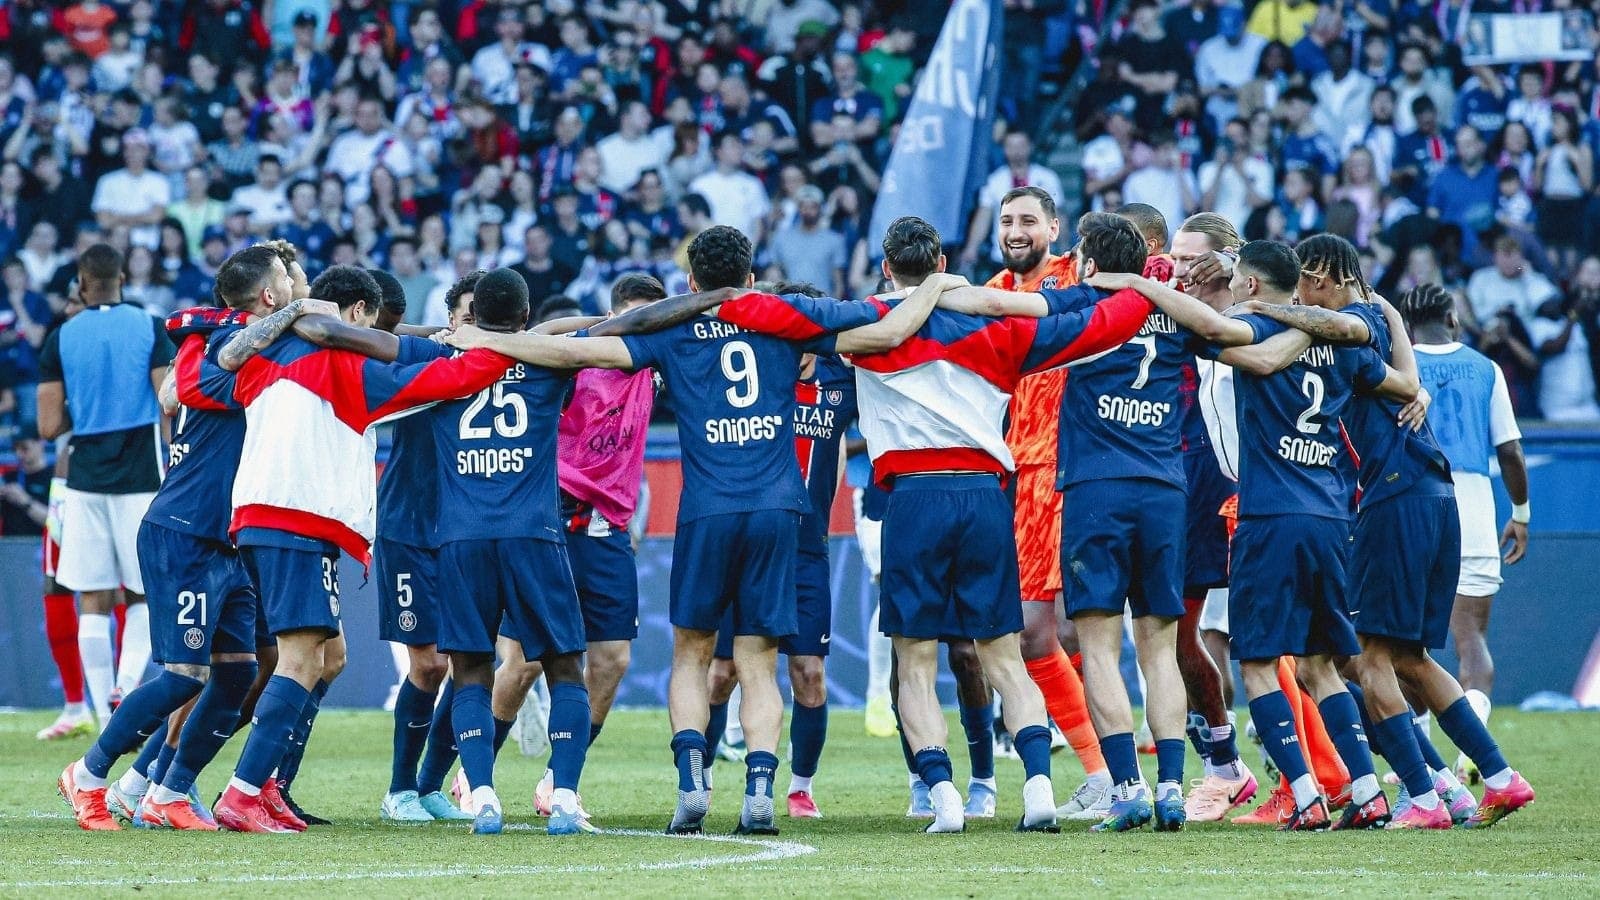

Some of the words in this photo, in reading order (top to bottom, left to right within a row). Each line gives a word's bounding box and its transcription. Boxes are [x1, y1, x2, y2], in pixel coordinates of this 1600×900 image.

[720, 340, 759, 408] 9
[1127, 333, 1157, 390] 7
[459, 380, 528, 440] 25
[1098, 394, 1170, 428] snipes
[1296, 371, 1325, 434] 2
[705, 415, 782, 446] snipes
[457, 448, 532, 478] snipes
[177, 590, 207, 626] 21
[396, 573, 413, 608] 5
